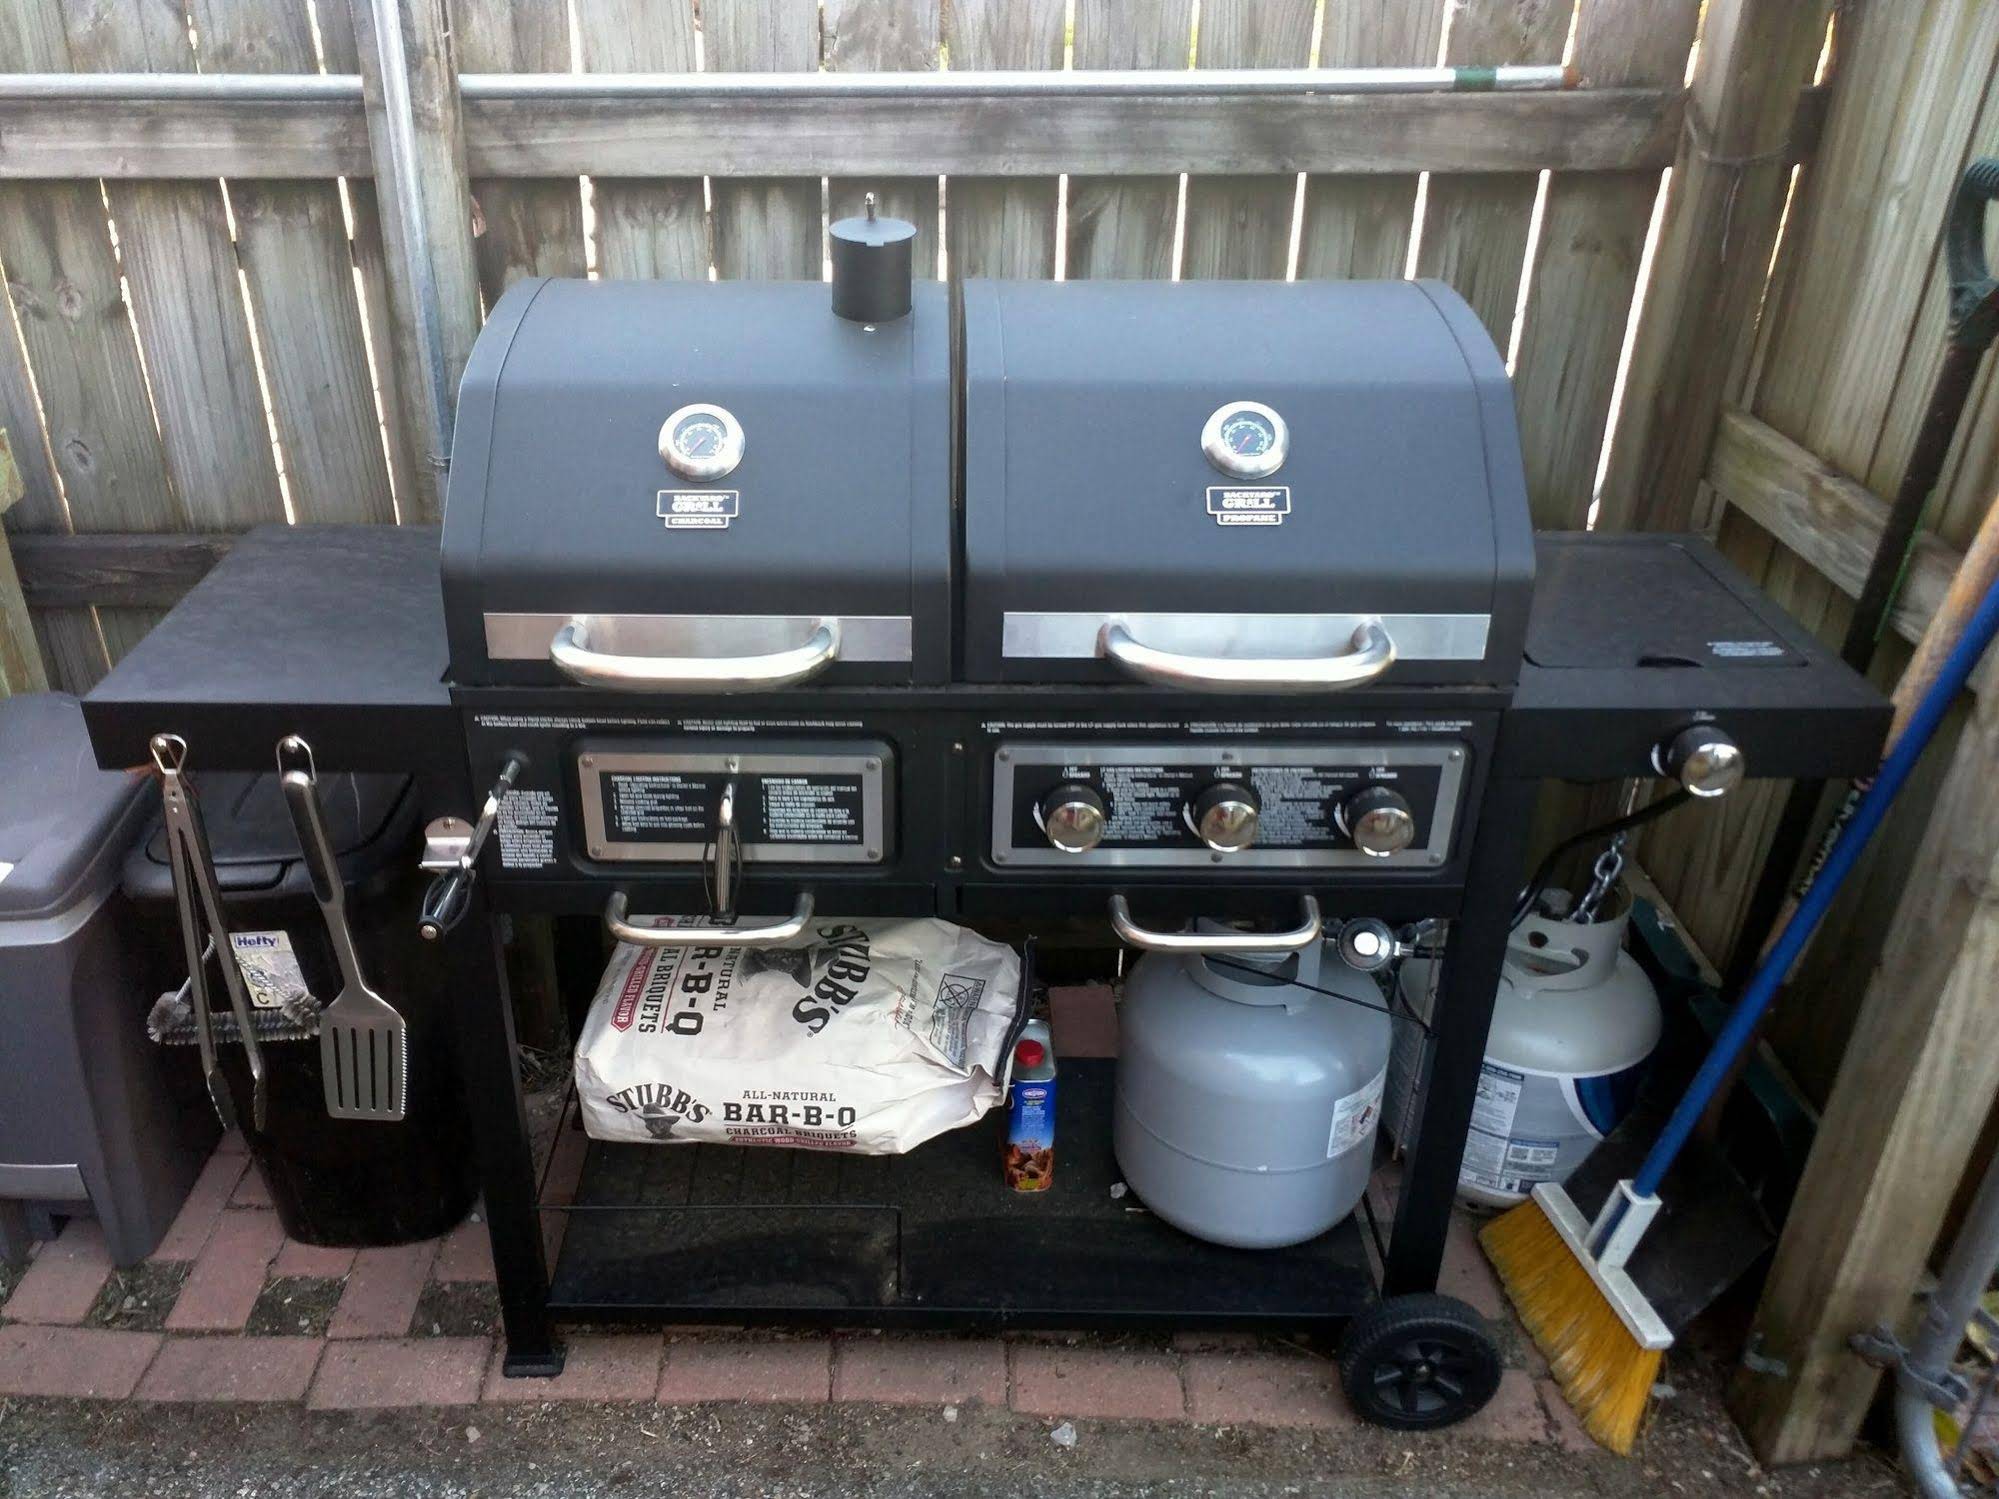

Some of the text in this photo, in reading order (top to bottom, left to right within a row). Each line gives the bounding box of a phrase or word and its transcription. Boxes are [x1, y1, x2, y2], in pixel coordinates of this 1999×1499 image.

[237, 936, 276, 947] Hefty
[713, 946, 741, 1012] NATURAL
[617, 994, 636, 1023] FLAVOR
[638, 965, 674, 1033] BRIQUETS
[606, 1083, 710, 1123] STUBB'S
[742, 1090, 836, 1102] ALL-NATURAL
[726, 1127, 792, 1136] CHARCOAL
